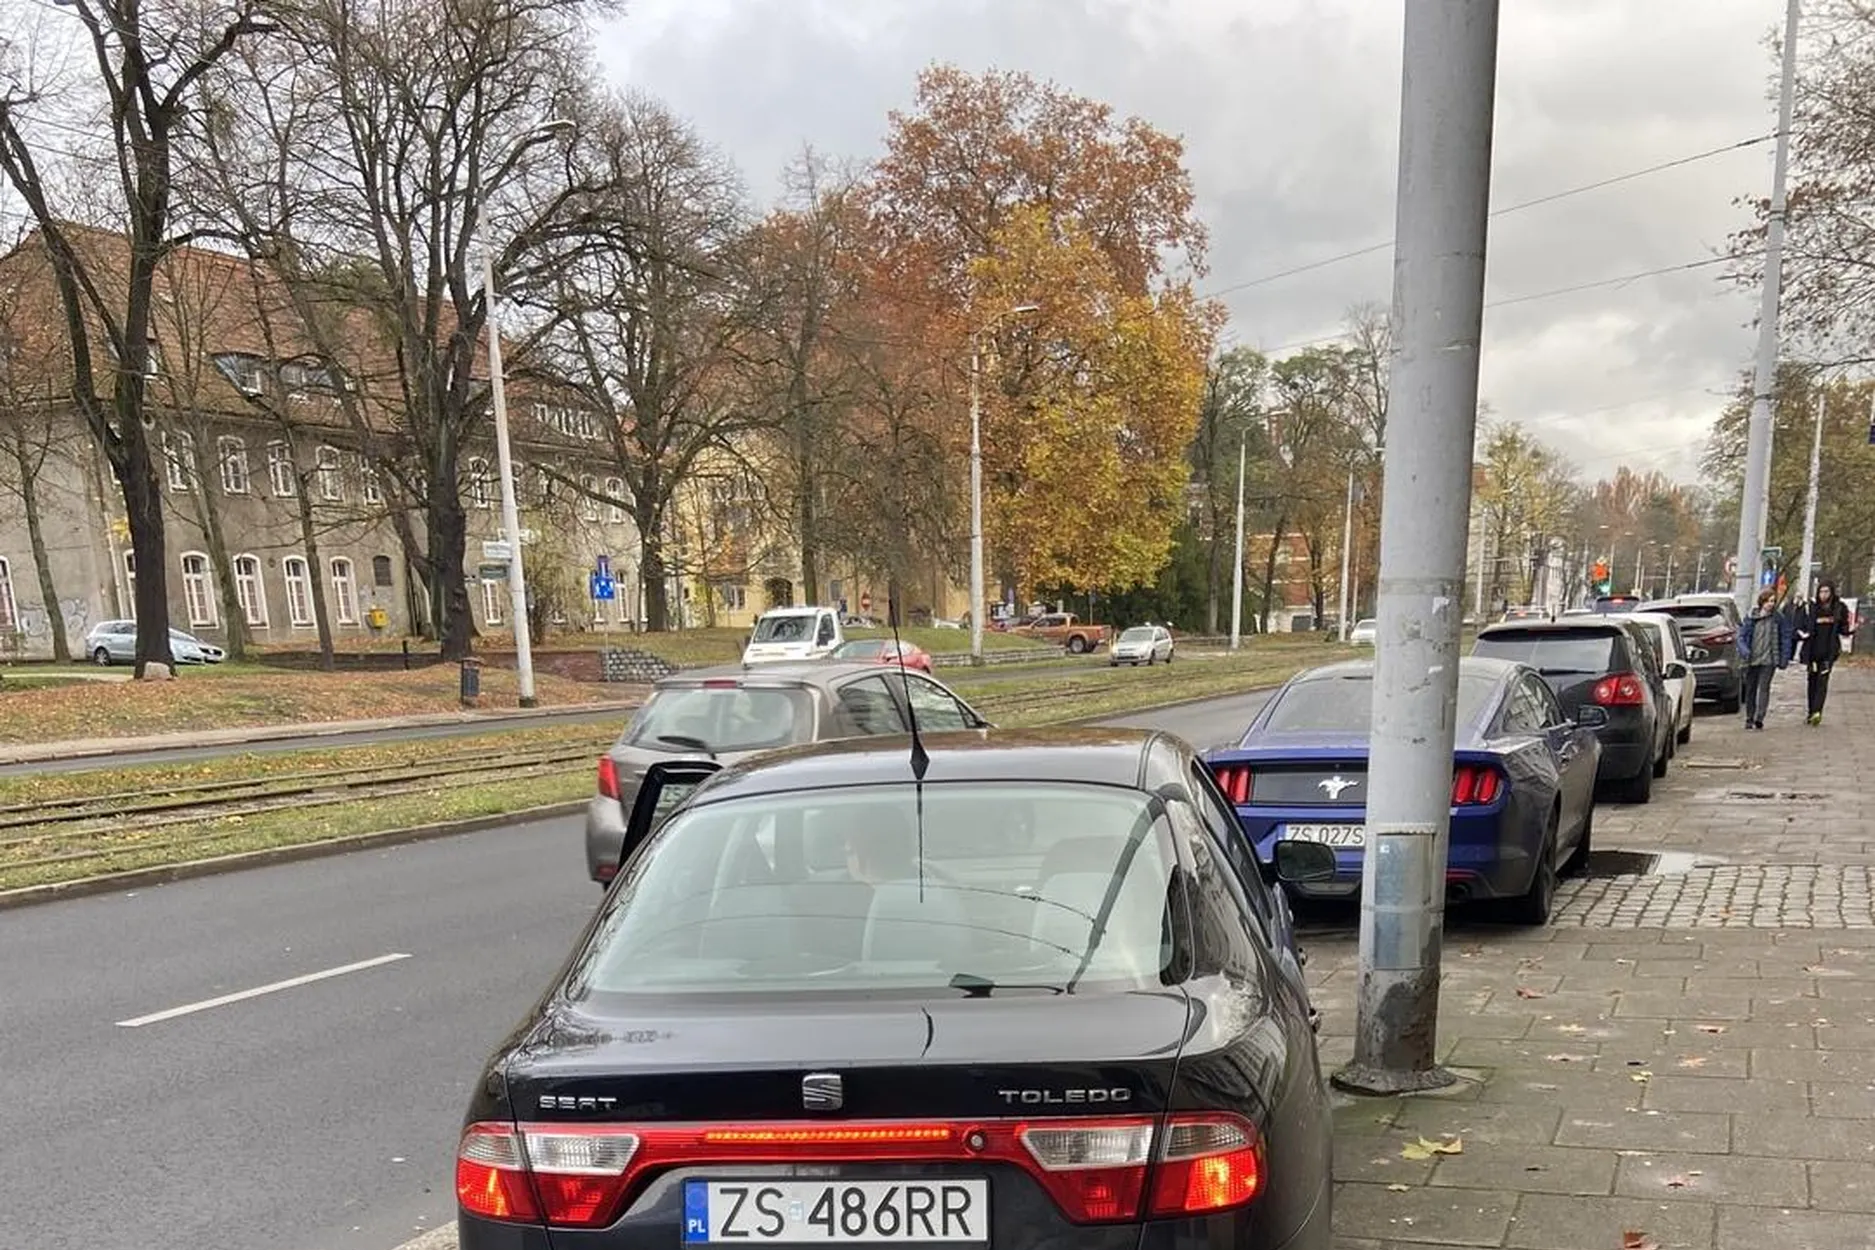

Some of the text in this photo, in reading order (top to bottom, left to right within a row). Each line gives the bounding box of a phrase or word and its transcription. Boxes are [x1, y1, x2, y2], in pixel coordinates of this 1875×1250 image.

[1319, 826, 1364, 845] 027S
[540, 1095, 617, 1110] SEAT
[999, 1088, 1131, 1103] TOLEDO
[719, 1186, 972, 1238] ZS 486RR
[688, 1219, 706, 1234] PL
